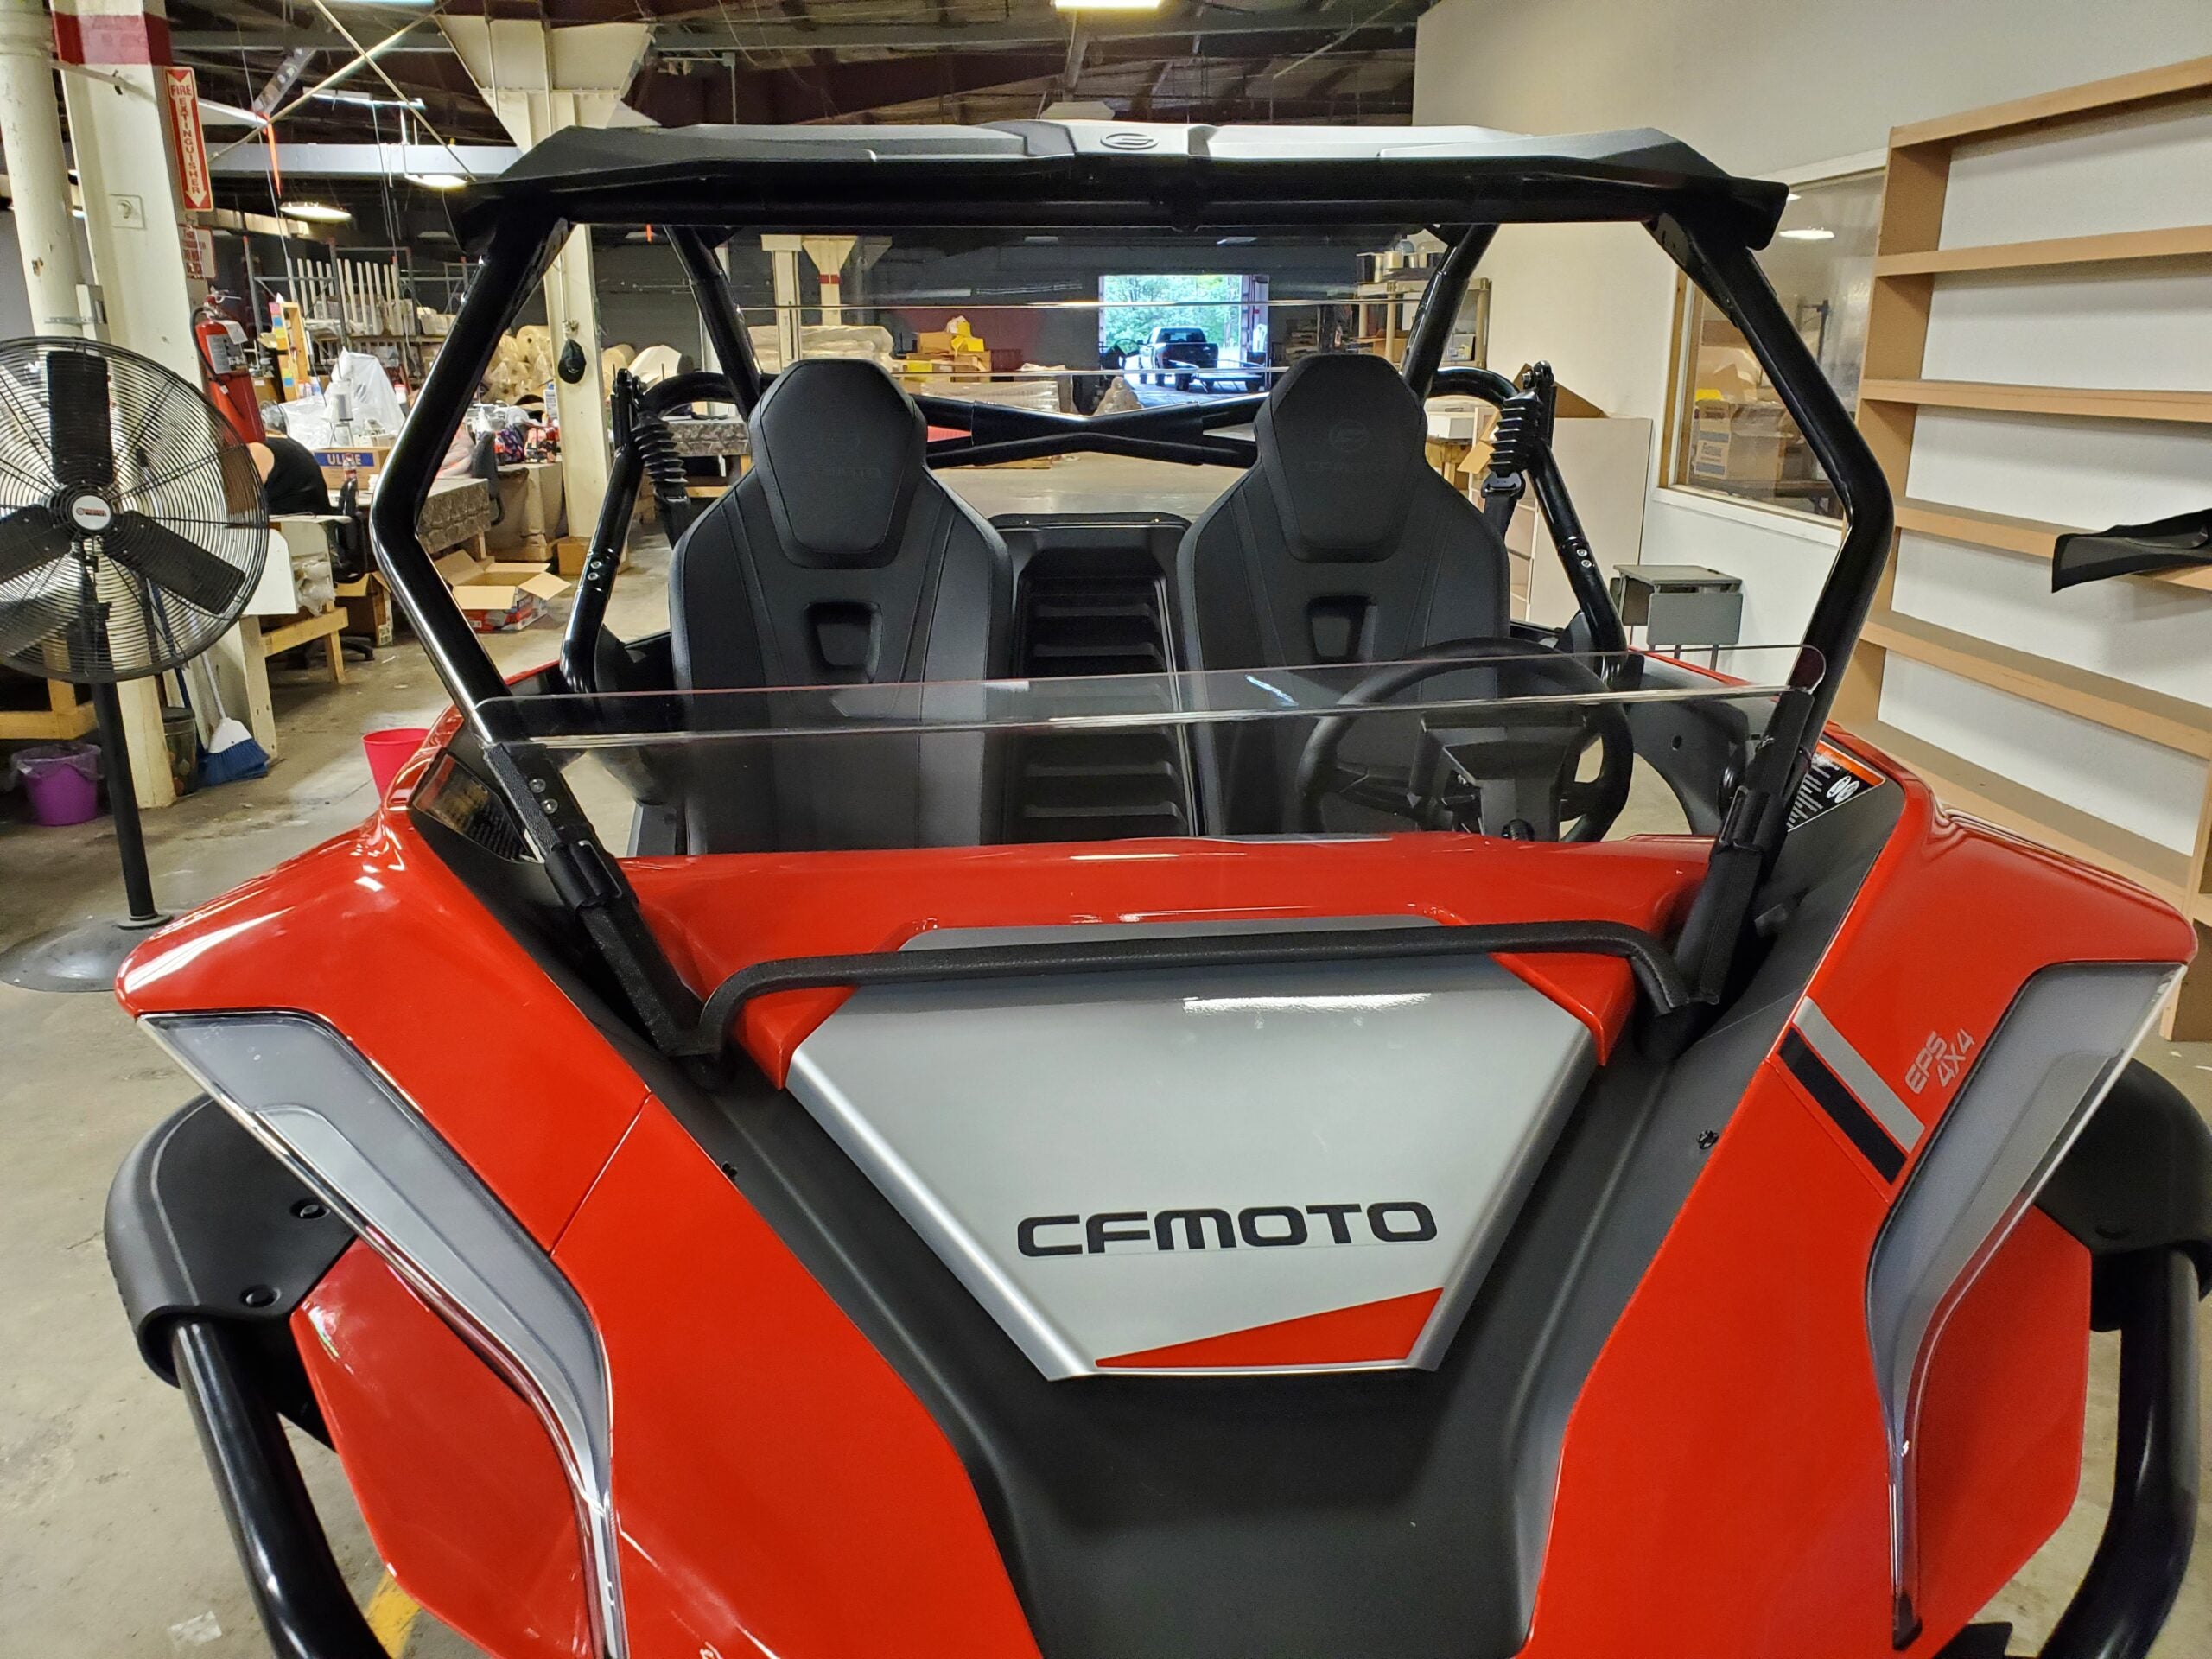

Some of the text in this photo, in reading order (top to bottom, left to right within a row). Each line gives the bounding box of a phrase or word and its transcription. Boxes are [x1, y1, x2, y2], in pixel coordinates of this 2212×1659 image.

[170, 85, 192, 96] FIRE
[179, 98, 200, 194] EXTINGUISHER
[1904, 1030, 1948, 1095] EPS
[1017, 1201, 1438, 1257] CFMOTO
